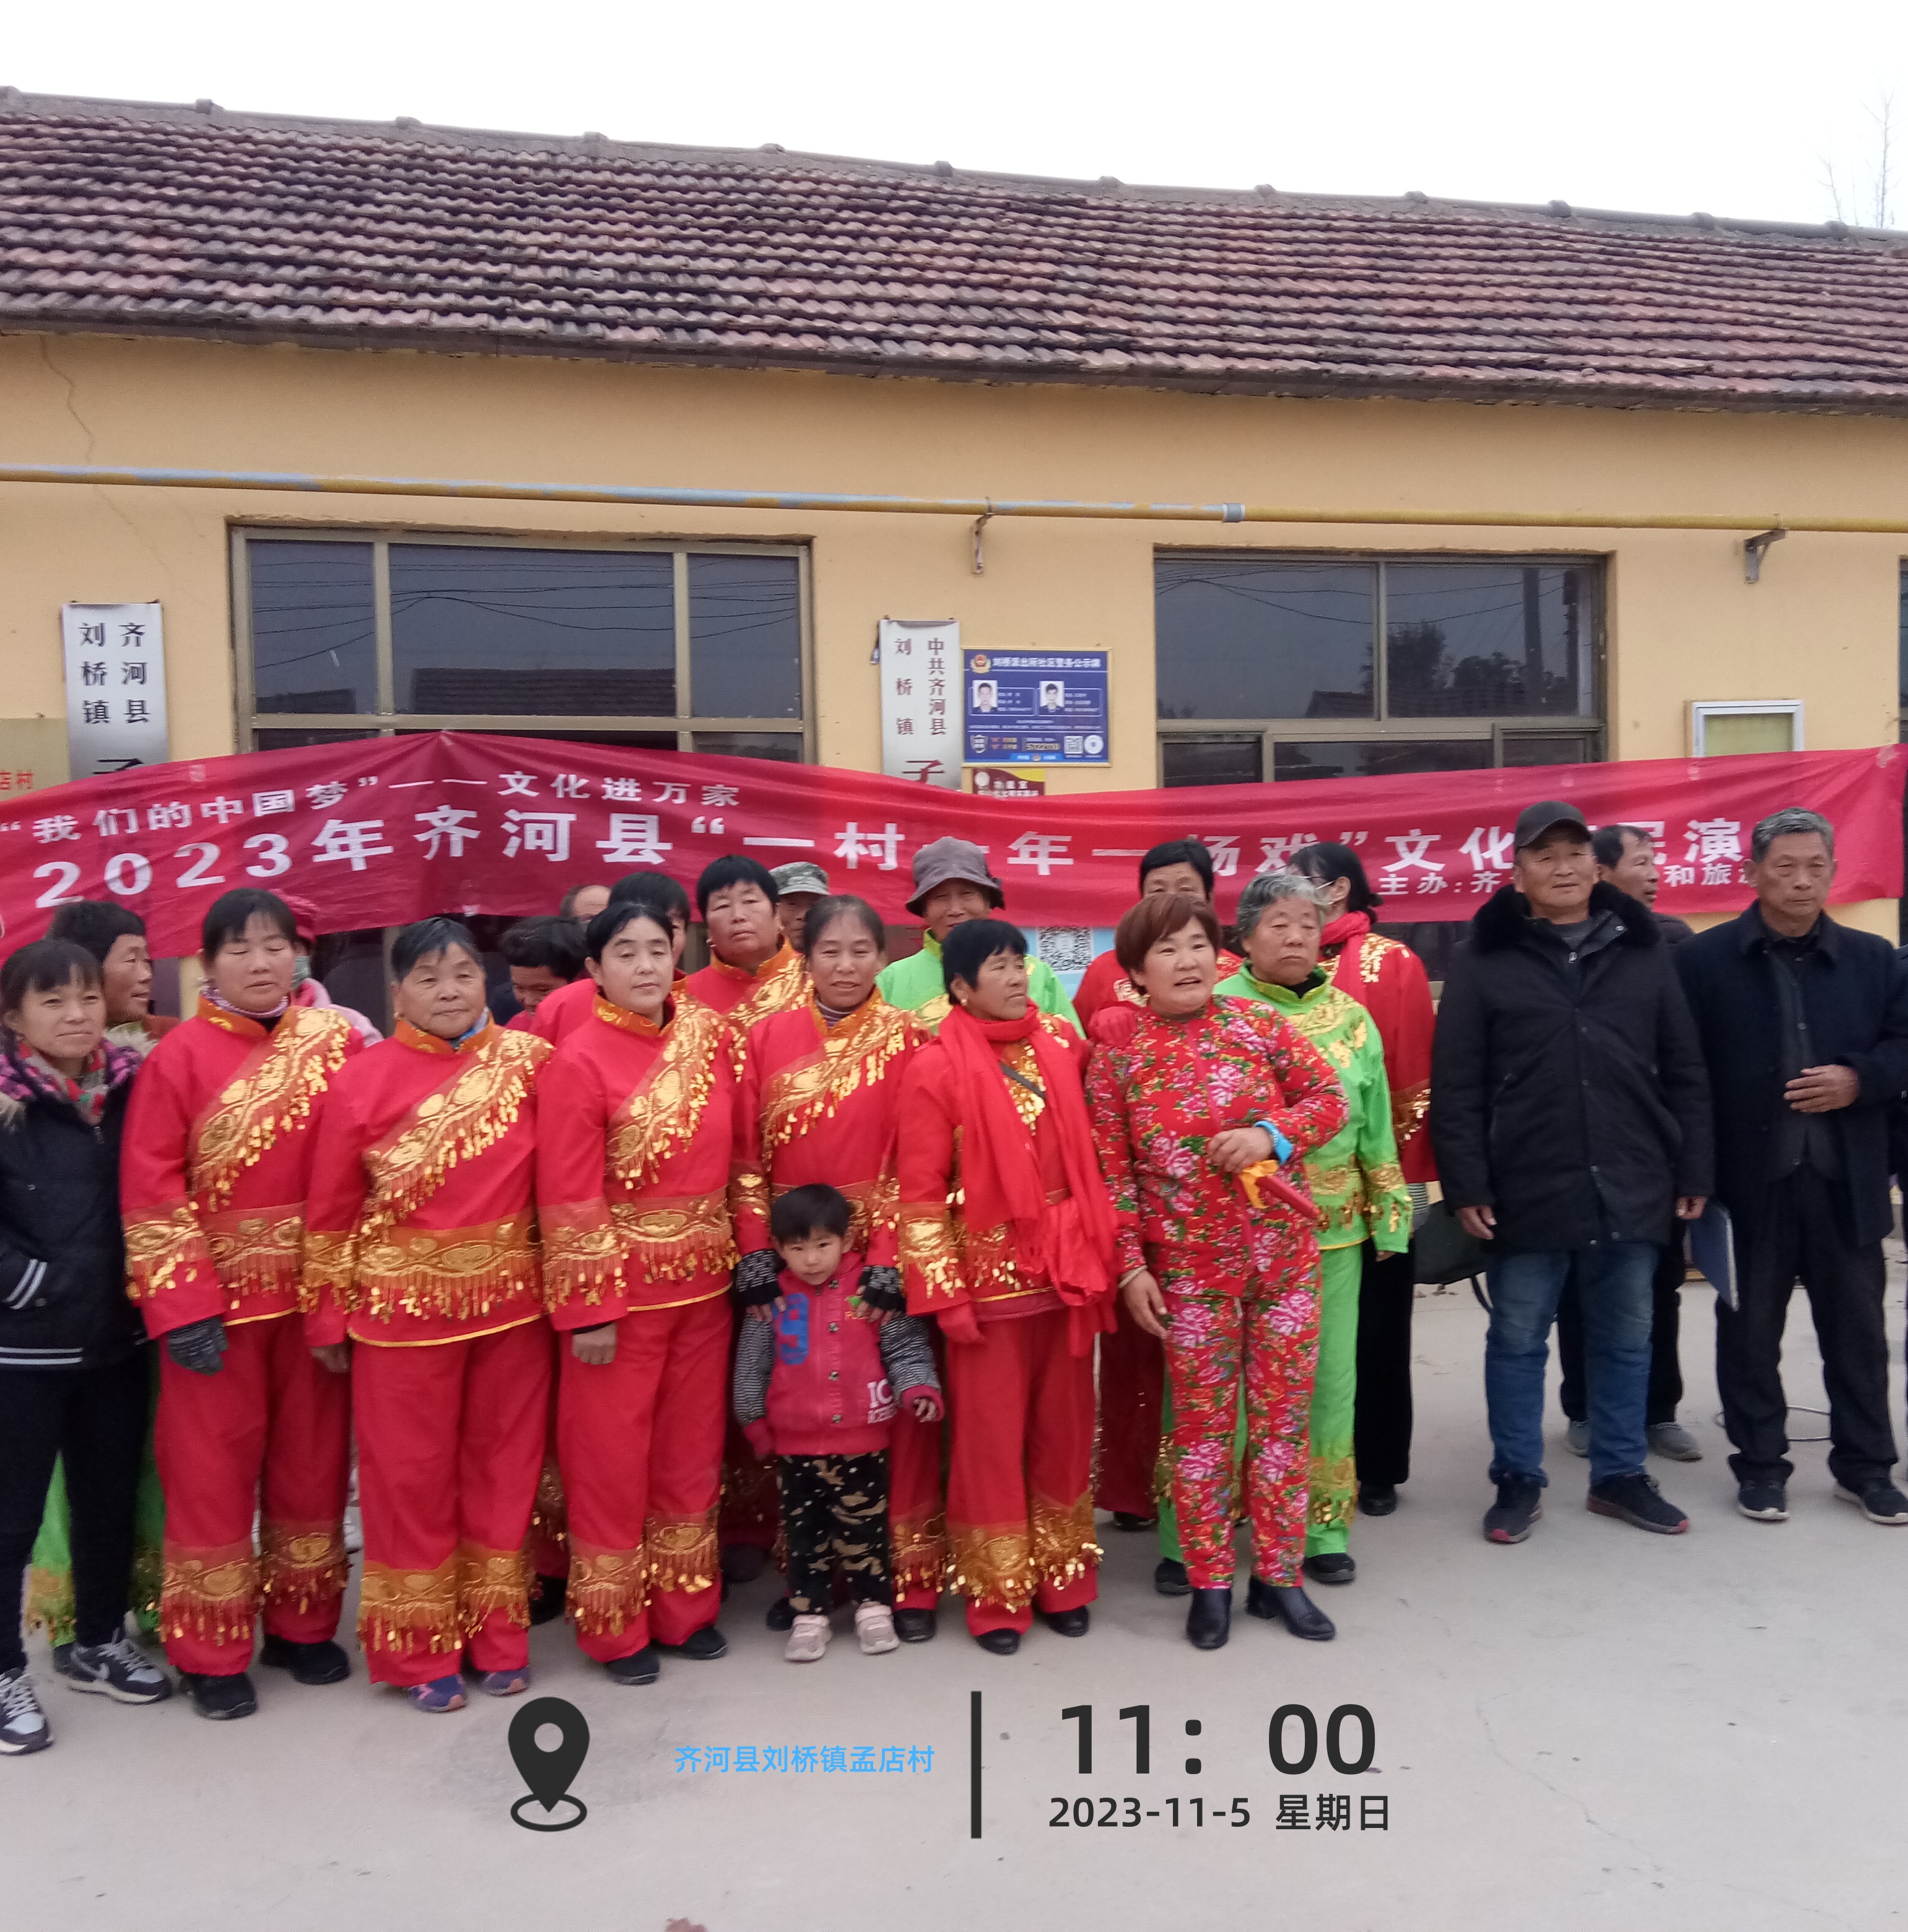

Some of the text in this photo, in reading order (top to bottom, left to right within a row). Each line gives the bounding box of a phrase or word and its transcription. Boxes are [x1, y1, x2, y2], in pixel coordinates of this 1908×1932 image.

[79, 621, 111, 724] 刘桥镇
[120, 621, 150, 724] 齐河县
[895, 638, 914, 735] 刘桥镇
[928, 638, 947, 735] 中共齐河县
